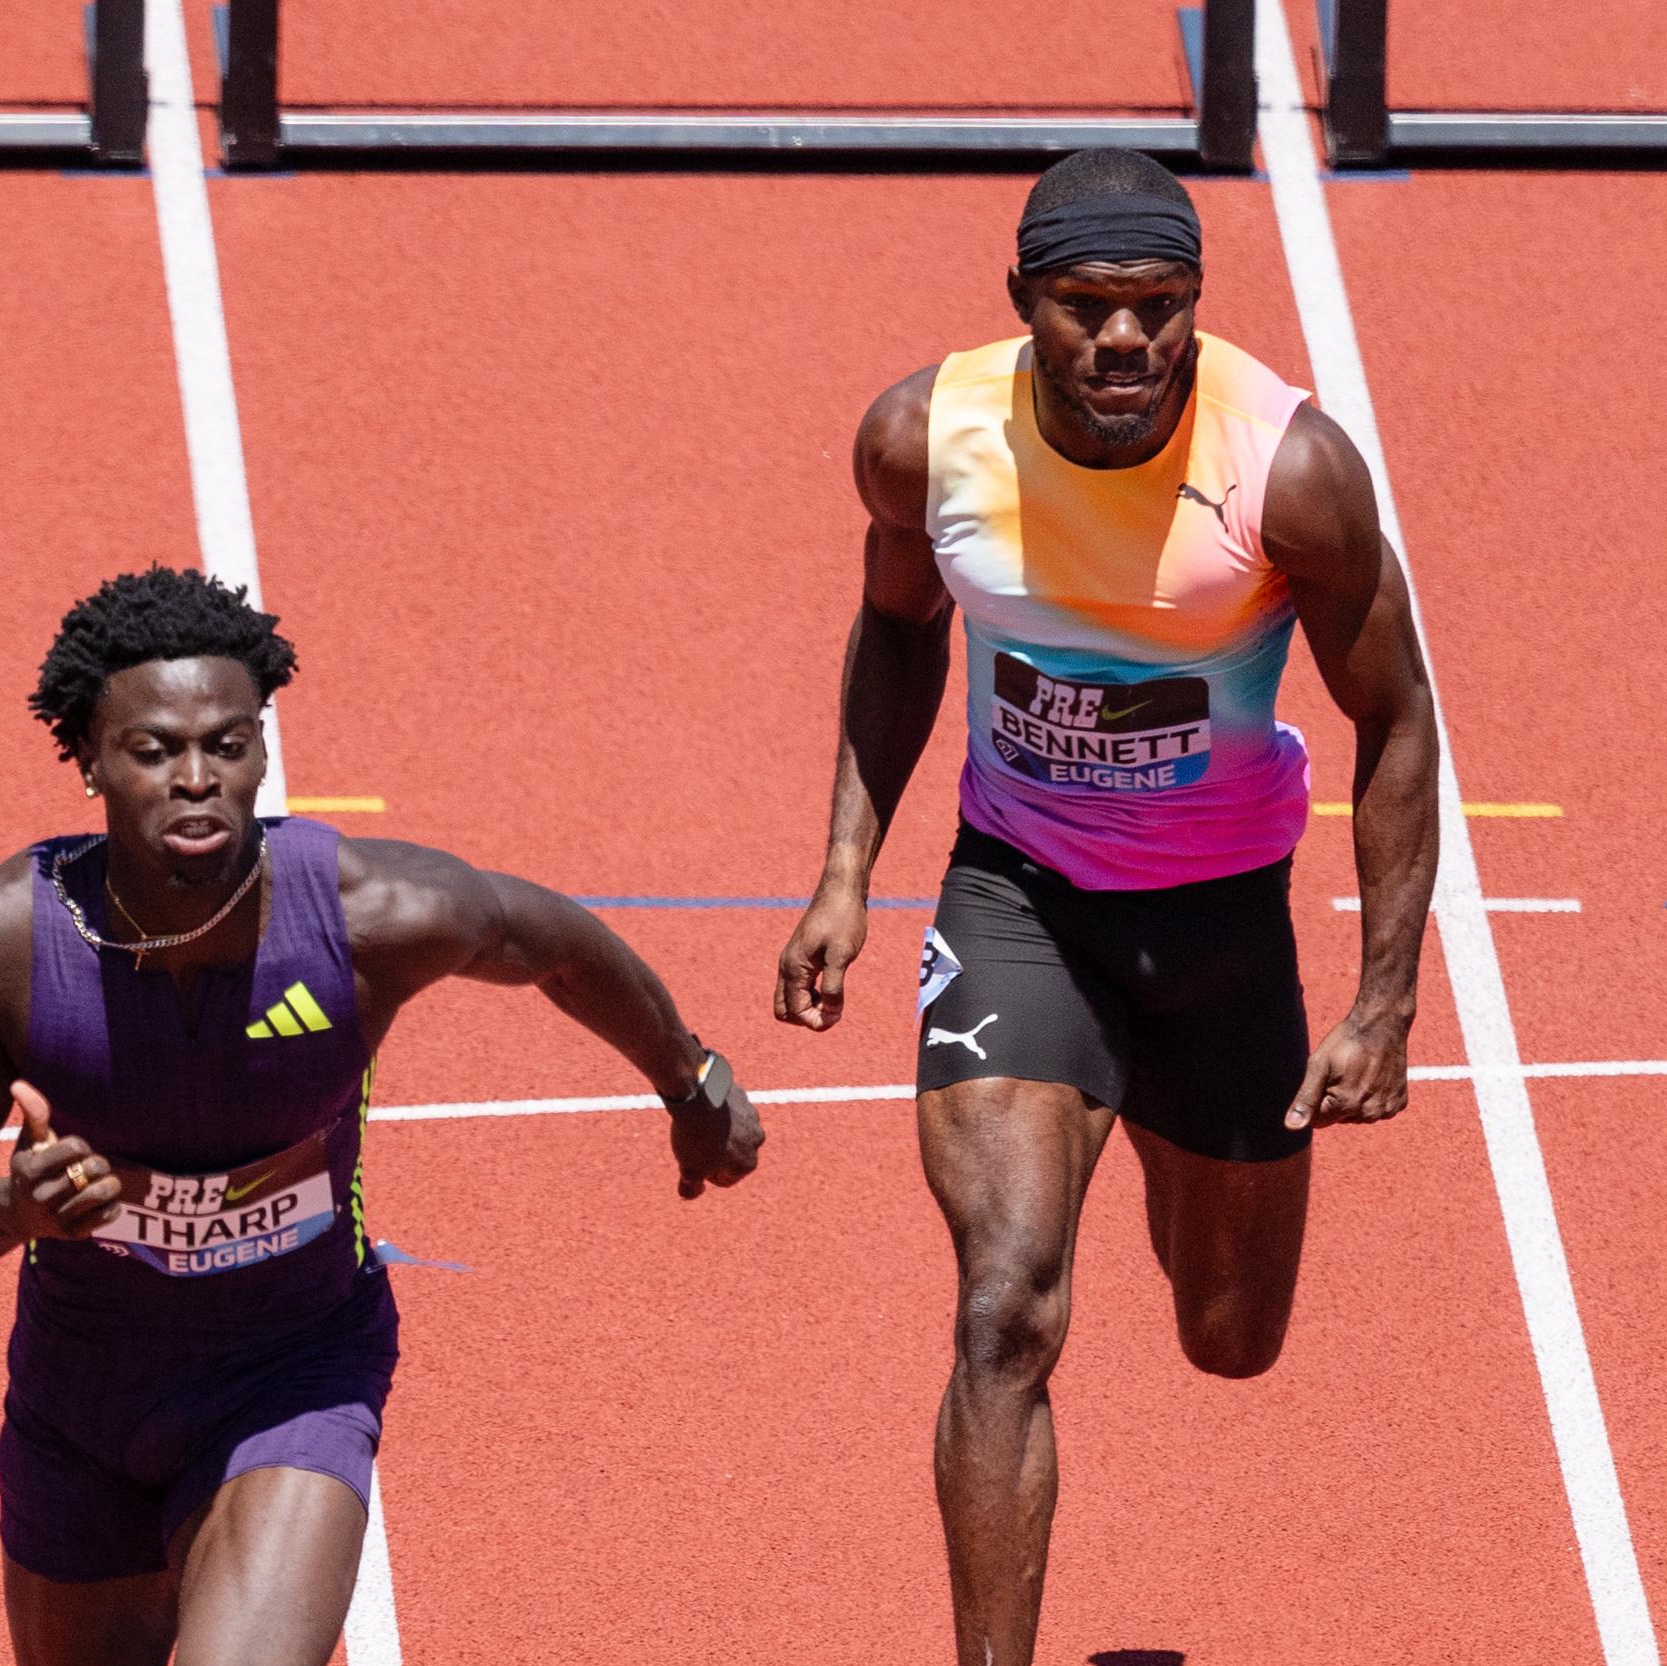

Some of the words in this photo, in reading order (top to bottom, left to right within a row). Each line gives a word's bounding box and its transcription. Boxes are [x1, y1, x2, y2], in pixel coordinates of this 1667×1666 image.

[1028, 674, 1104, 729] PRE
[1000, 706, 1200, 765] BENNETT
[1049, 763, 1177, 790] EUGENE
[144, 1172, 229, 1215] PRE
[127, 1192, 298, 1248] THARP
[168, 1227, 300, 1274] EUGENE
